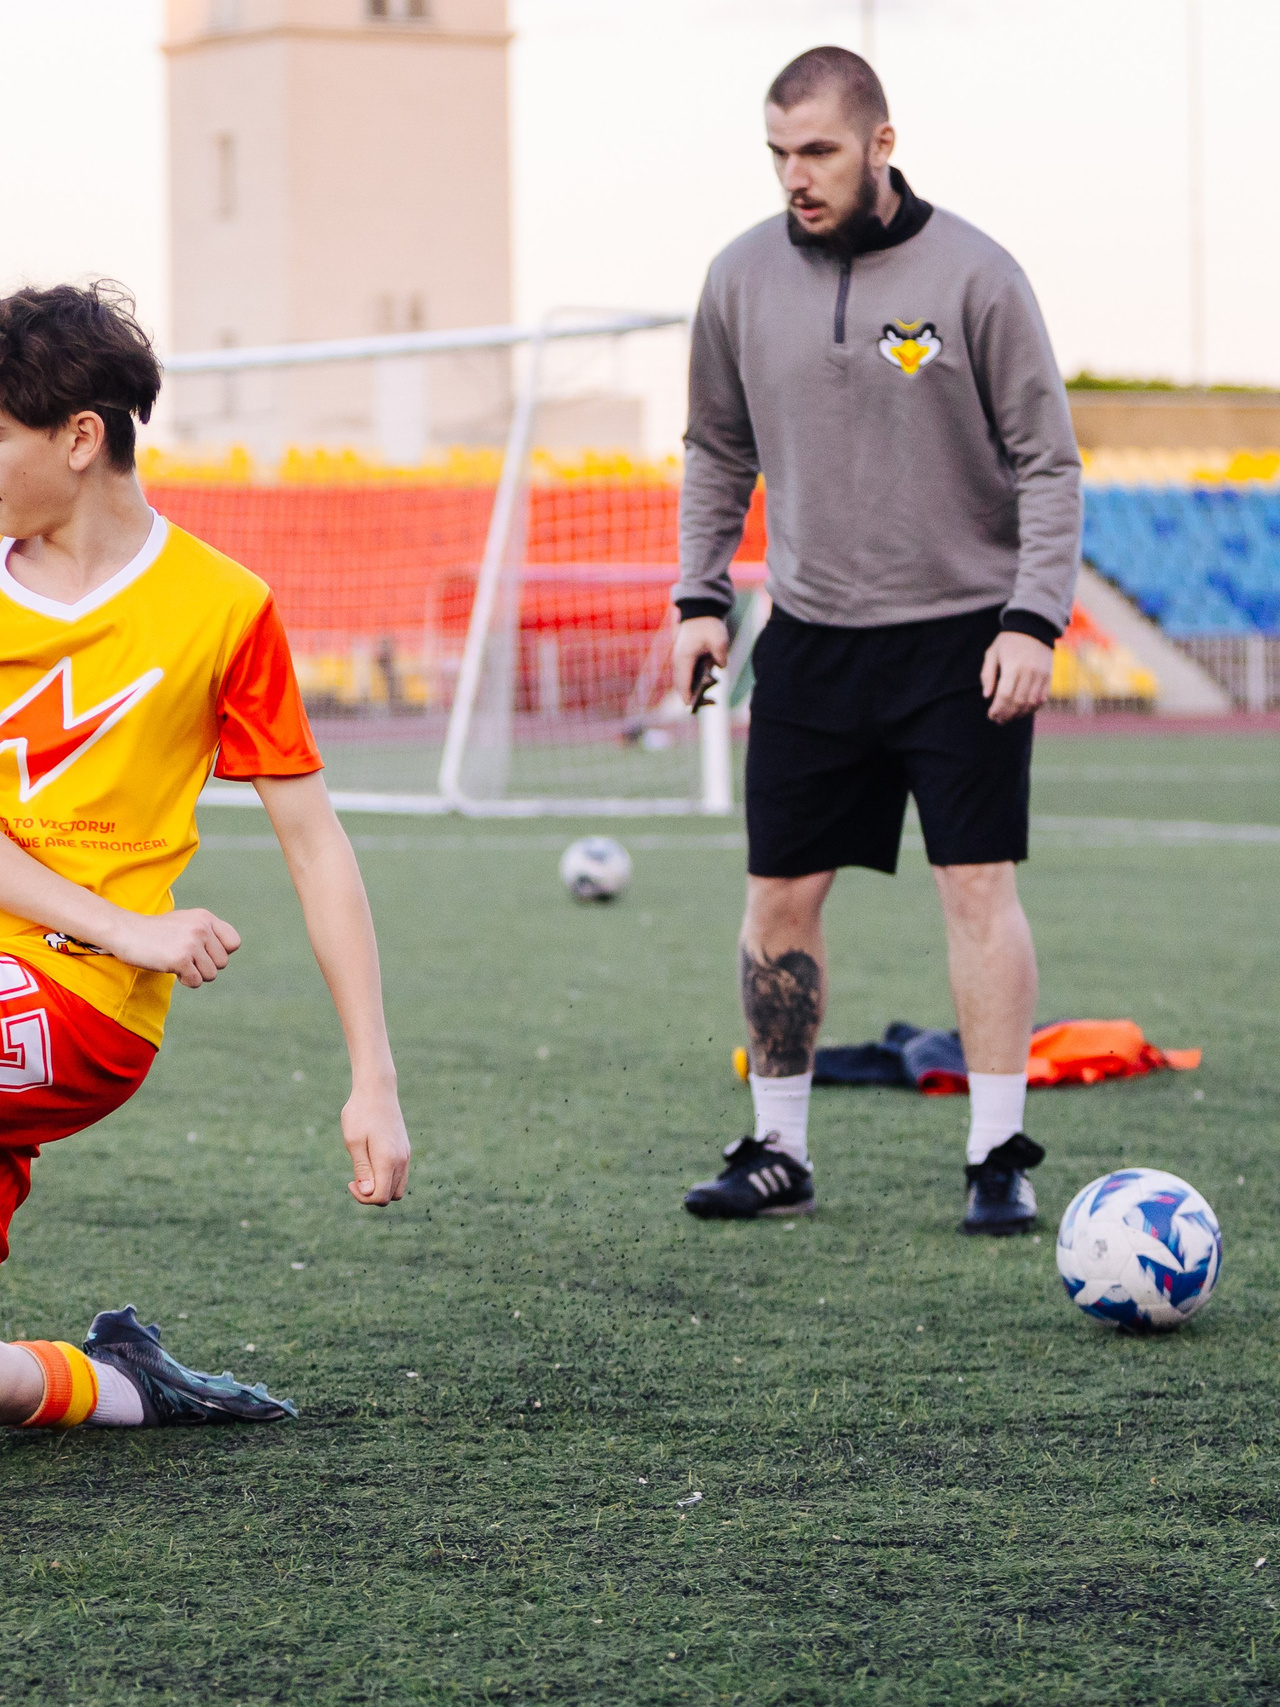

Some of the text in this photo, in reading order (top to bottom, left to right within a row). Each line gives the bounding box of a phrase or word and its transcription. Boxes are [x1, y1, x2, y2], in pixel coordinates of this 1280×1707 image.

[13, 817, 34, 829] TO
[39, 817, 116, 834] VICTORY!
[45, 836, 78, 849] ARE
[80, 838, 169, 853] STRONGER!
